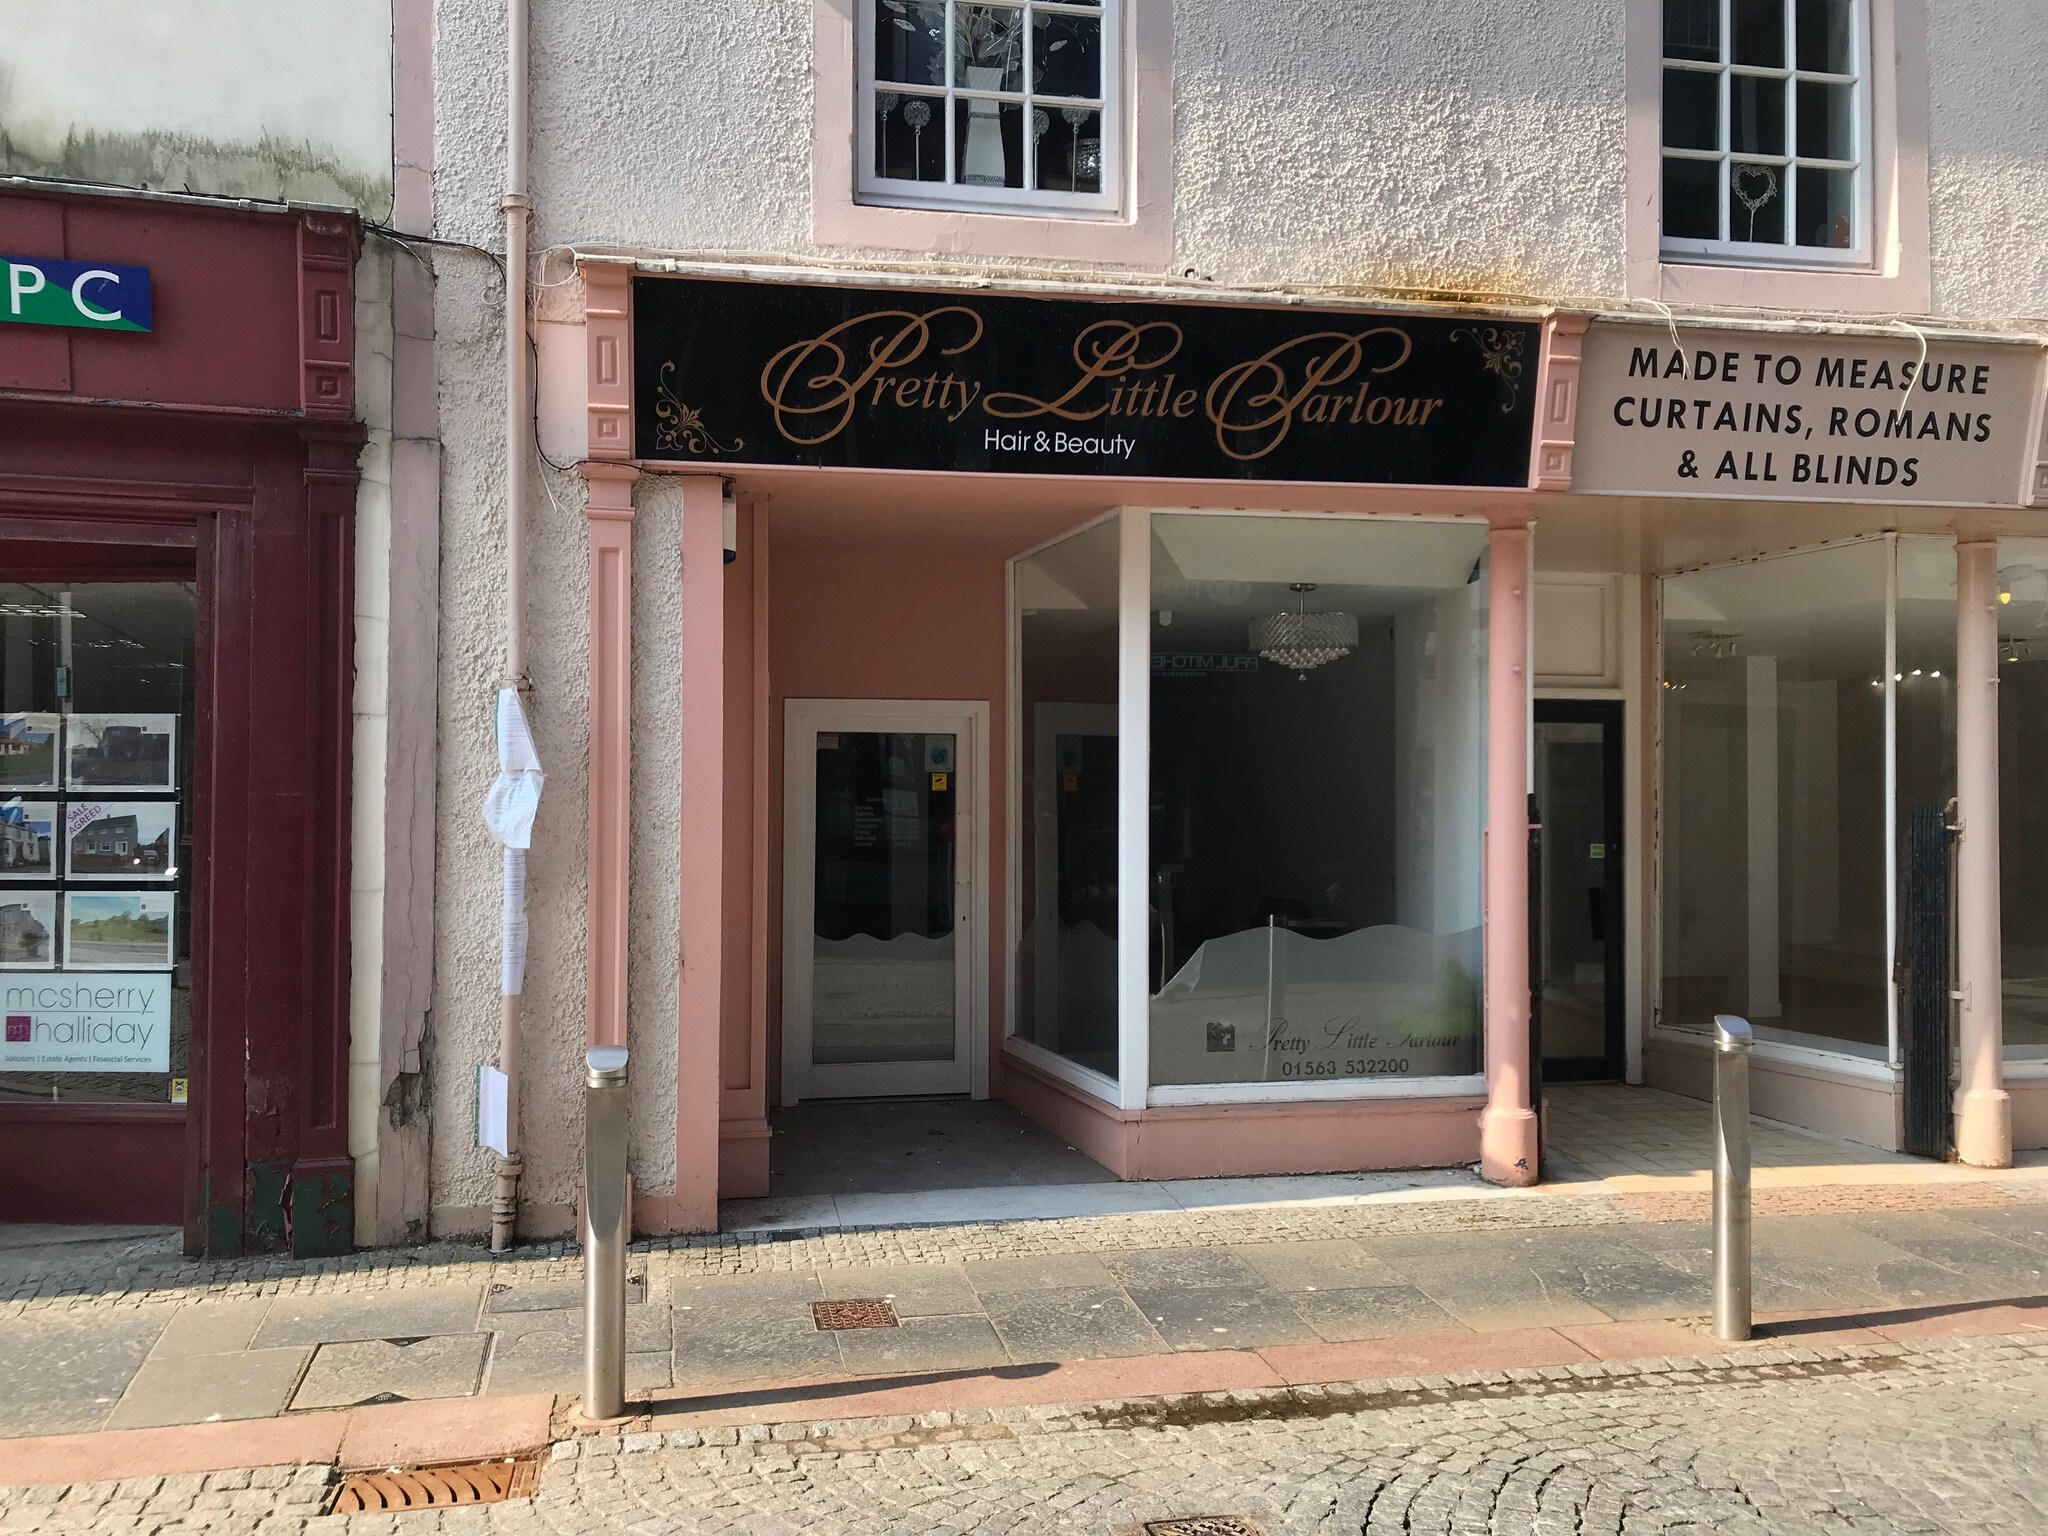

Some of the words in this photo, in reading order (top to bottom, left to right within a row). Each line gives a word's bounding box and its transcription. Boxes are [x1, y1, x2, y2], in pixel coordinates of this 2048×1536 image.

[761, 306, 983, 445] Pretty
[982, 319, 1198, 421] Little
[1205, 327, 1443, 461] Parlour
[1628, 346, 1740, 383] MADE
[1753, 353, 1802, 386] TO
[1814, 357, 1990, 395] MEASURE
[1613, 396, 1814, 441] CURTAINS,
[1828, 406, 1992, 443] ROMANS
[1677, 449, 1699, 479] &
[1714, 450, 1778, 482] ALL
[1792, 453, 1919, 487] BLINDS
[67, 802, 89, 823] SALE
[69, 804, 102, 836] AGREED
[6, 981, 155, 1016] mcsherry
[34, 1016, 155, 1051] halliday
[1249, 1016, 1311, 1055] Pretty
[1315, 1015, 1379, 1049] Little
[42, 1055, 62, 1063] Estate
[64, 1055, 87, 1064] Agents
[92, 1055, 123, 1063] Financial
[123, 1055, 152, 1064] Services
[1281, 1060, 1337, 1077] 01563
[1344, 1058, 1410, 1074] 532200
